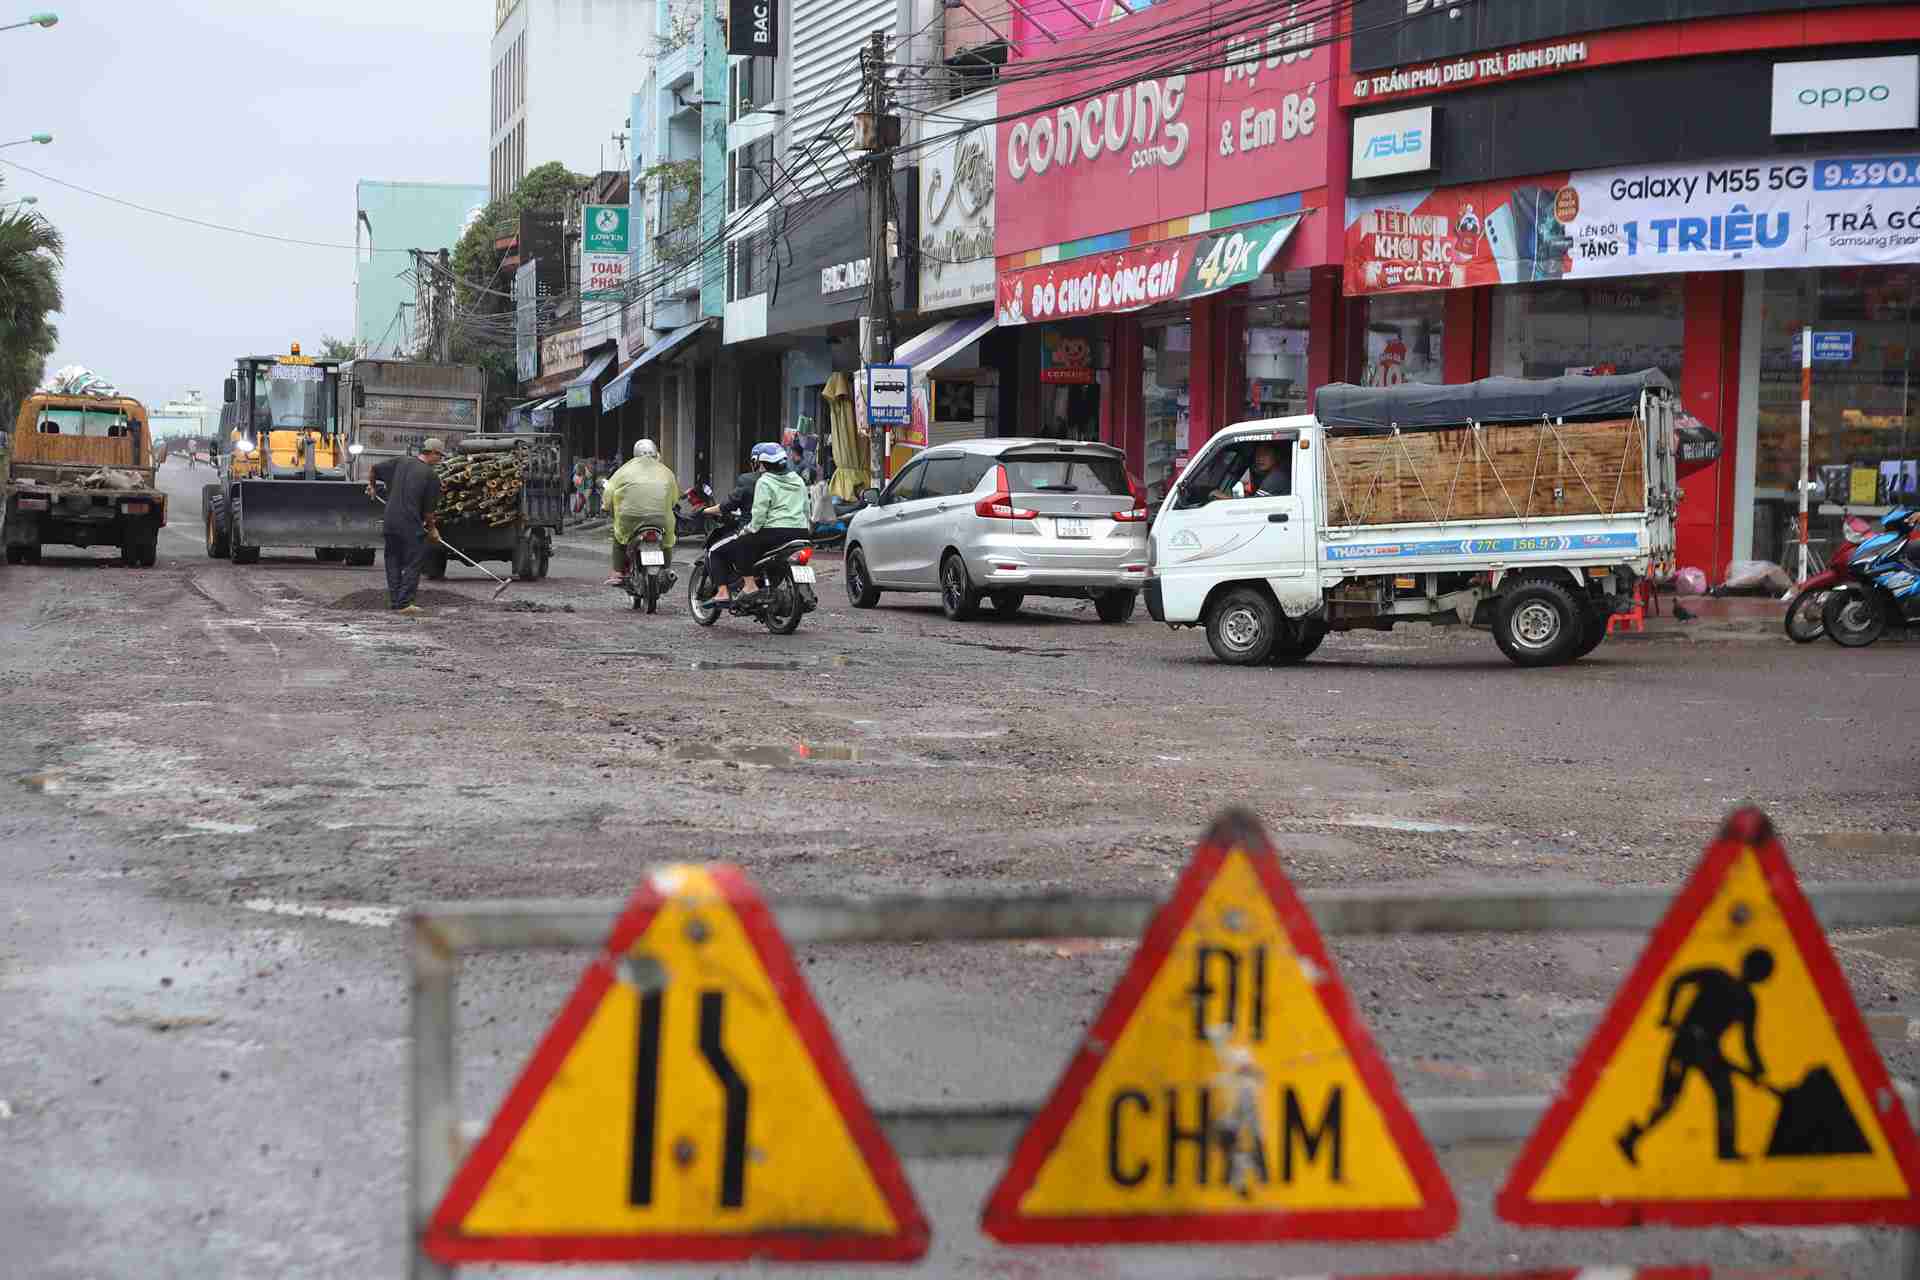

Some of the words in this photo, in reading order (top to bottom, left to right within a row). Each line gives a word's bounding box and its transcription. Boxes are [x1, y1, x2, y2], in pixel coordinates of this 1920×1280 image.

[753, 5, 768, 43] BAC
[1353, 79, 1369, 97] 47
[1798, 85, 1890, 109] oppo
[1219, 119, 1234, 156] &
[1240, 106, 1277, 152] Em
[1282, 81, 1317, 142] Bé
[1360, 128, 1424, 160] ASUS
[1610, 174, 1700, 203] Galaxy
[1705, 168, 1761, 195] M55
[1768, 165, 1809, 192] 5G
[1823, 161, 1920, 187] 9.390.
[1622, 220, 1639, 256] 1
[1649, 203, 1791, 260] TRIỆU
[1825, 204, 1878, 232] TRẢ
[1580, 238, 1620, 261] TẶNG
[1830, 235, 1887, 249] Samsung
[1032, 269, 1055, 317] ĐỒ
[1184, 941, 1268, 1043] ĐI
